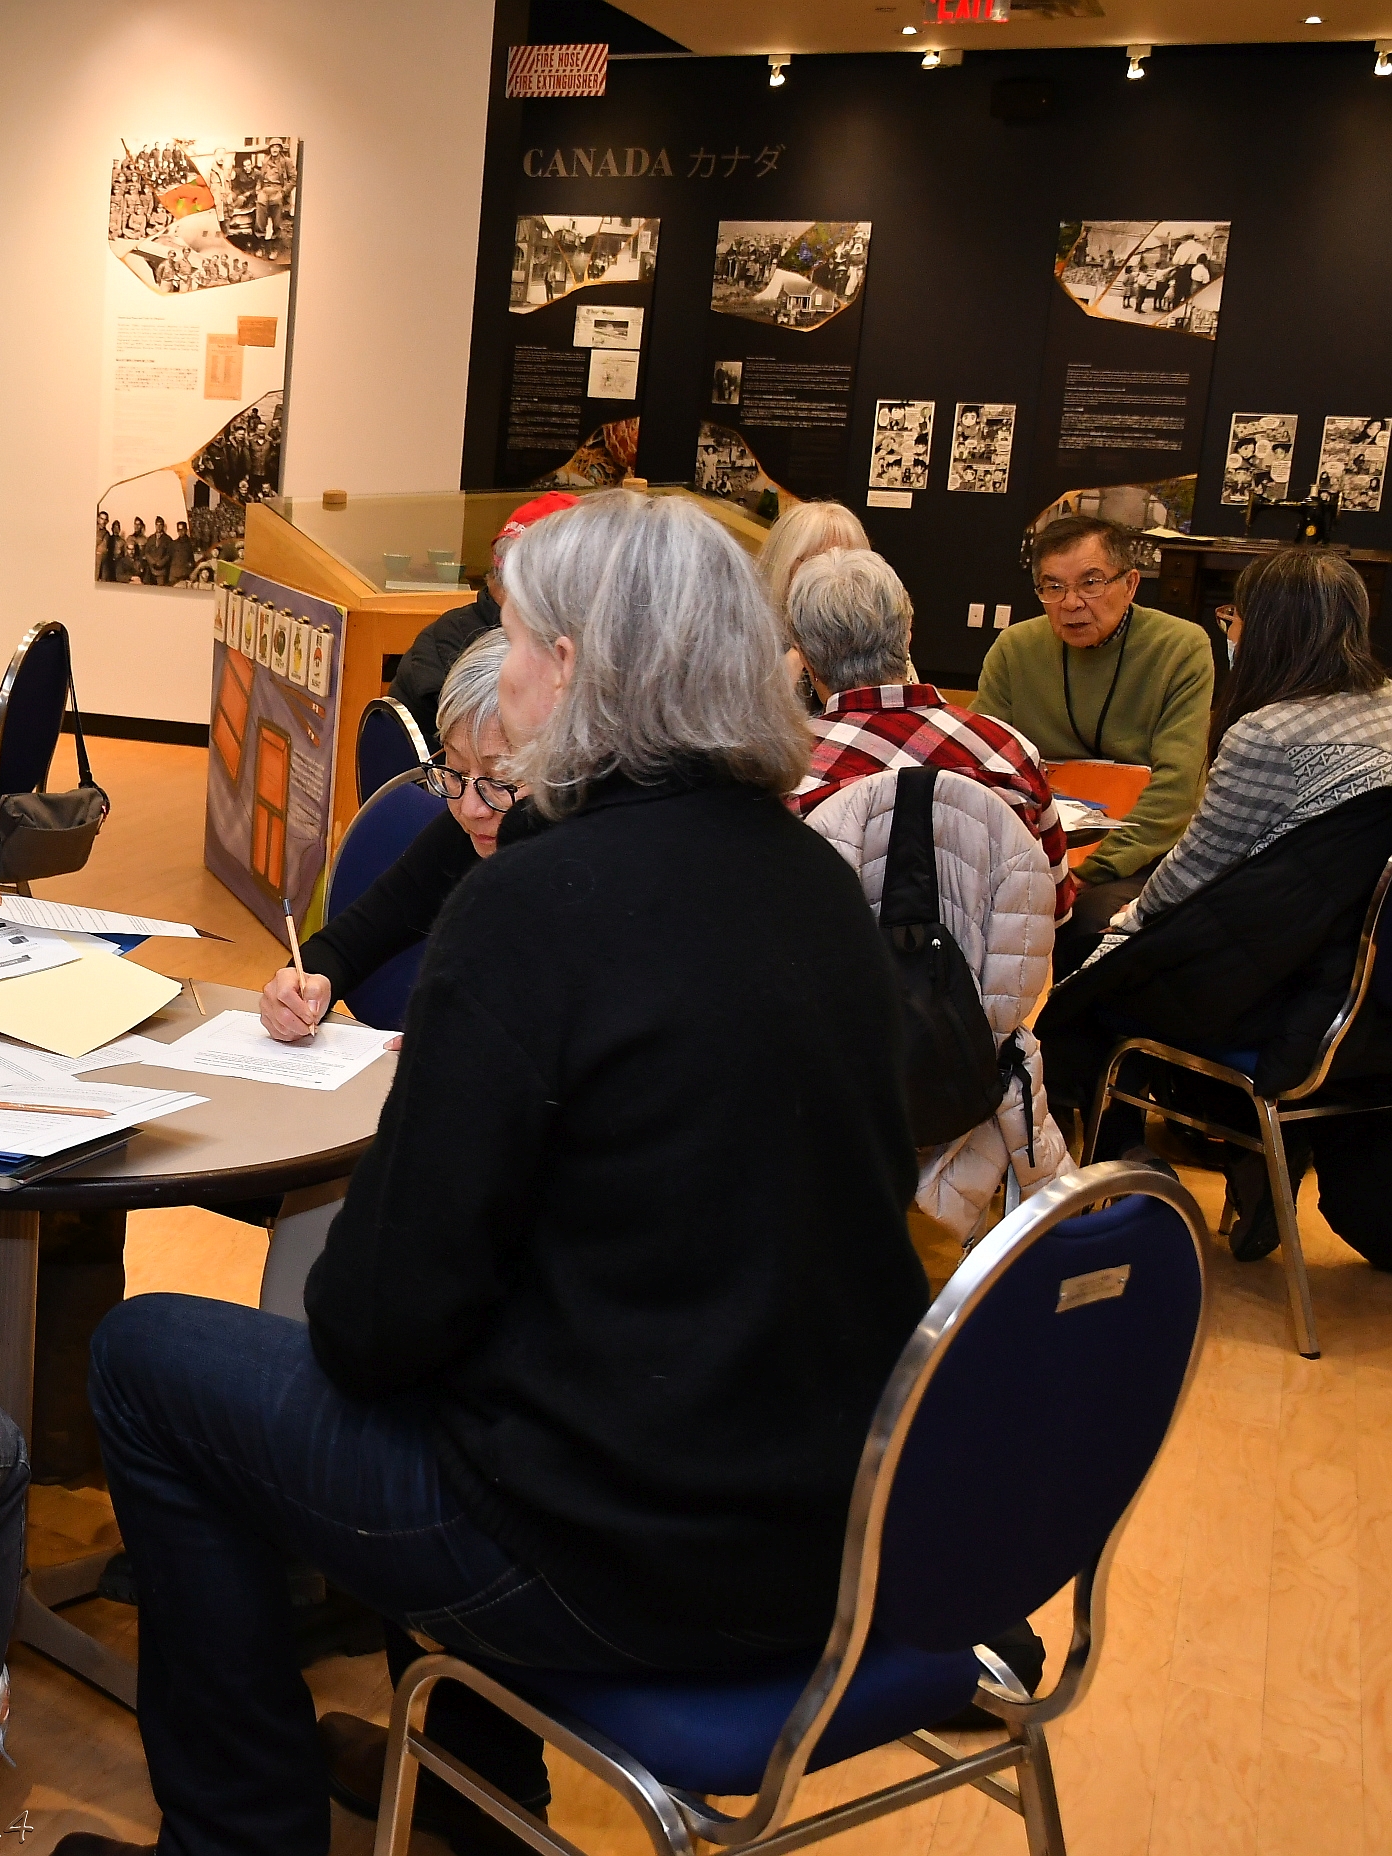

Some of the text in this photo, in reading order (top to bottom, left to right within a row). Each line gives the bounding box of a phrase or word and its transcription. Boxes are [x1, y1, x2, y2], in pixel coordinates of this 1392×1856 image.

[535, 51, 581, 68] FIRE HOSE
[514, 73, 600, 90] FIRE EXTINGUISHER
[522, 143, 787, 178] CANADA カナダ
